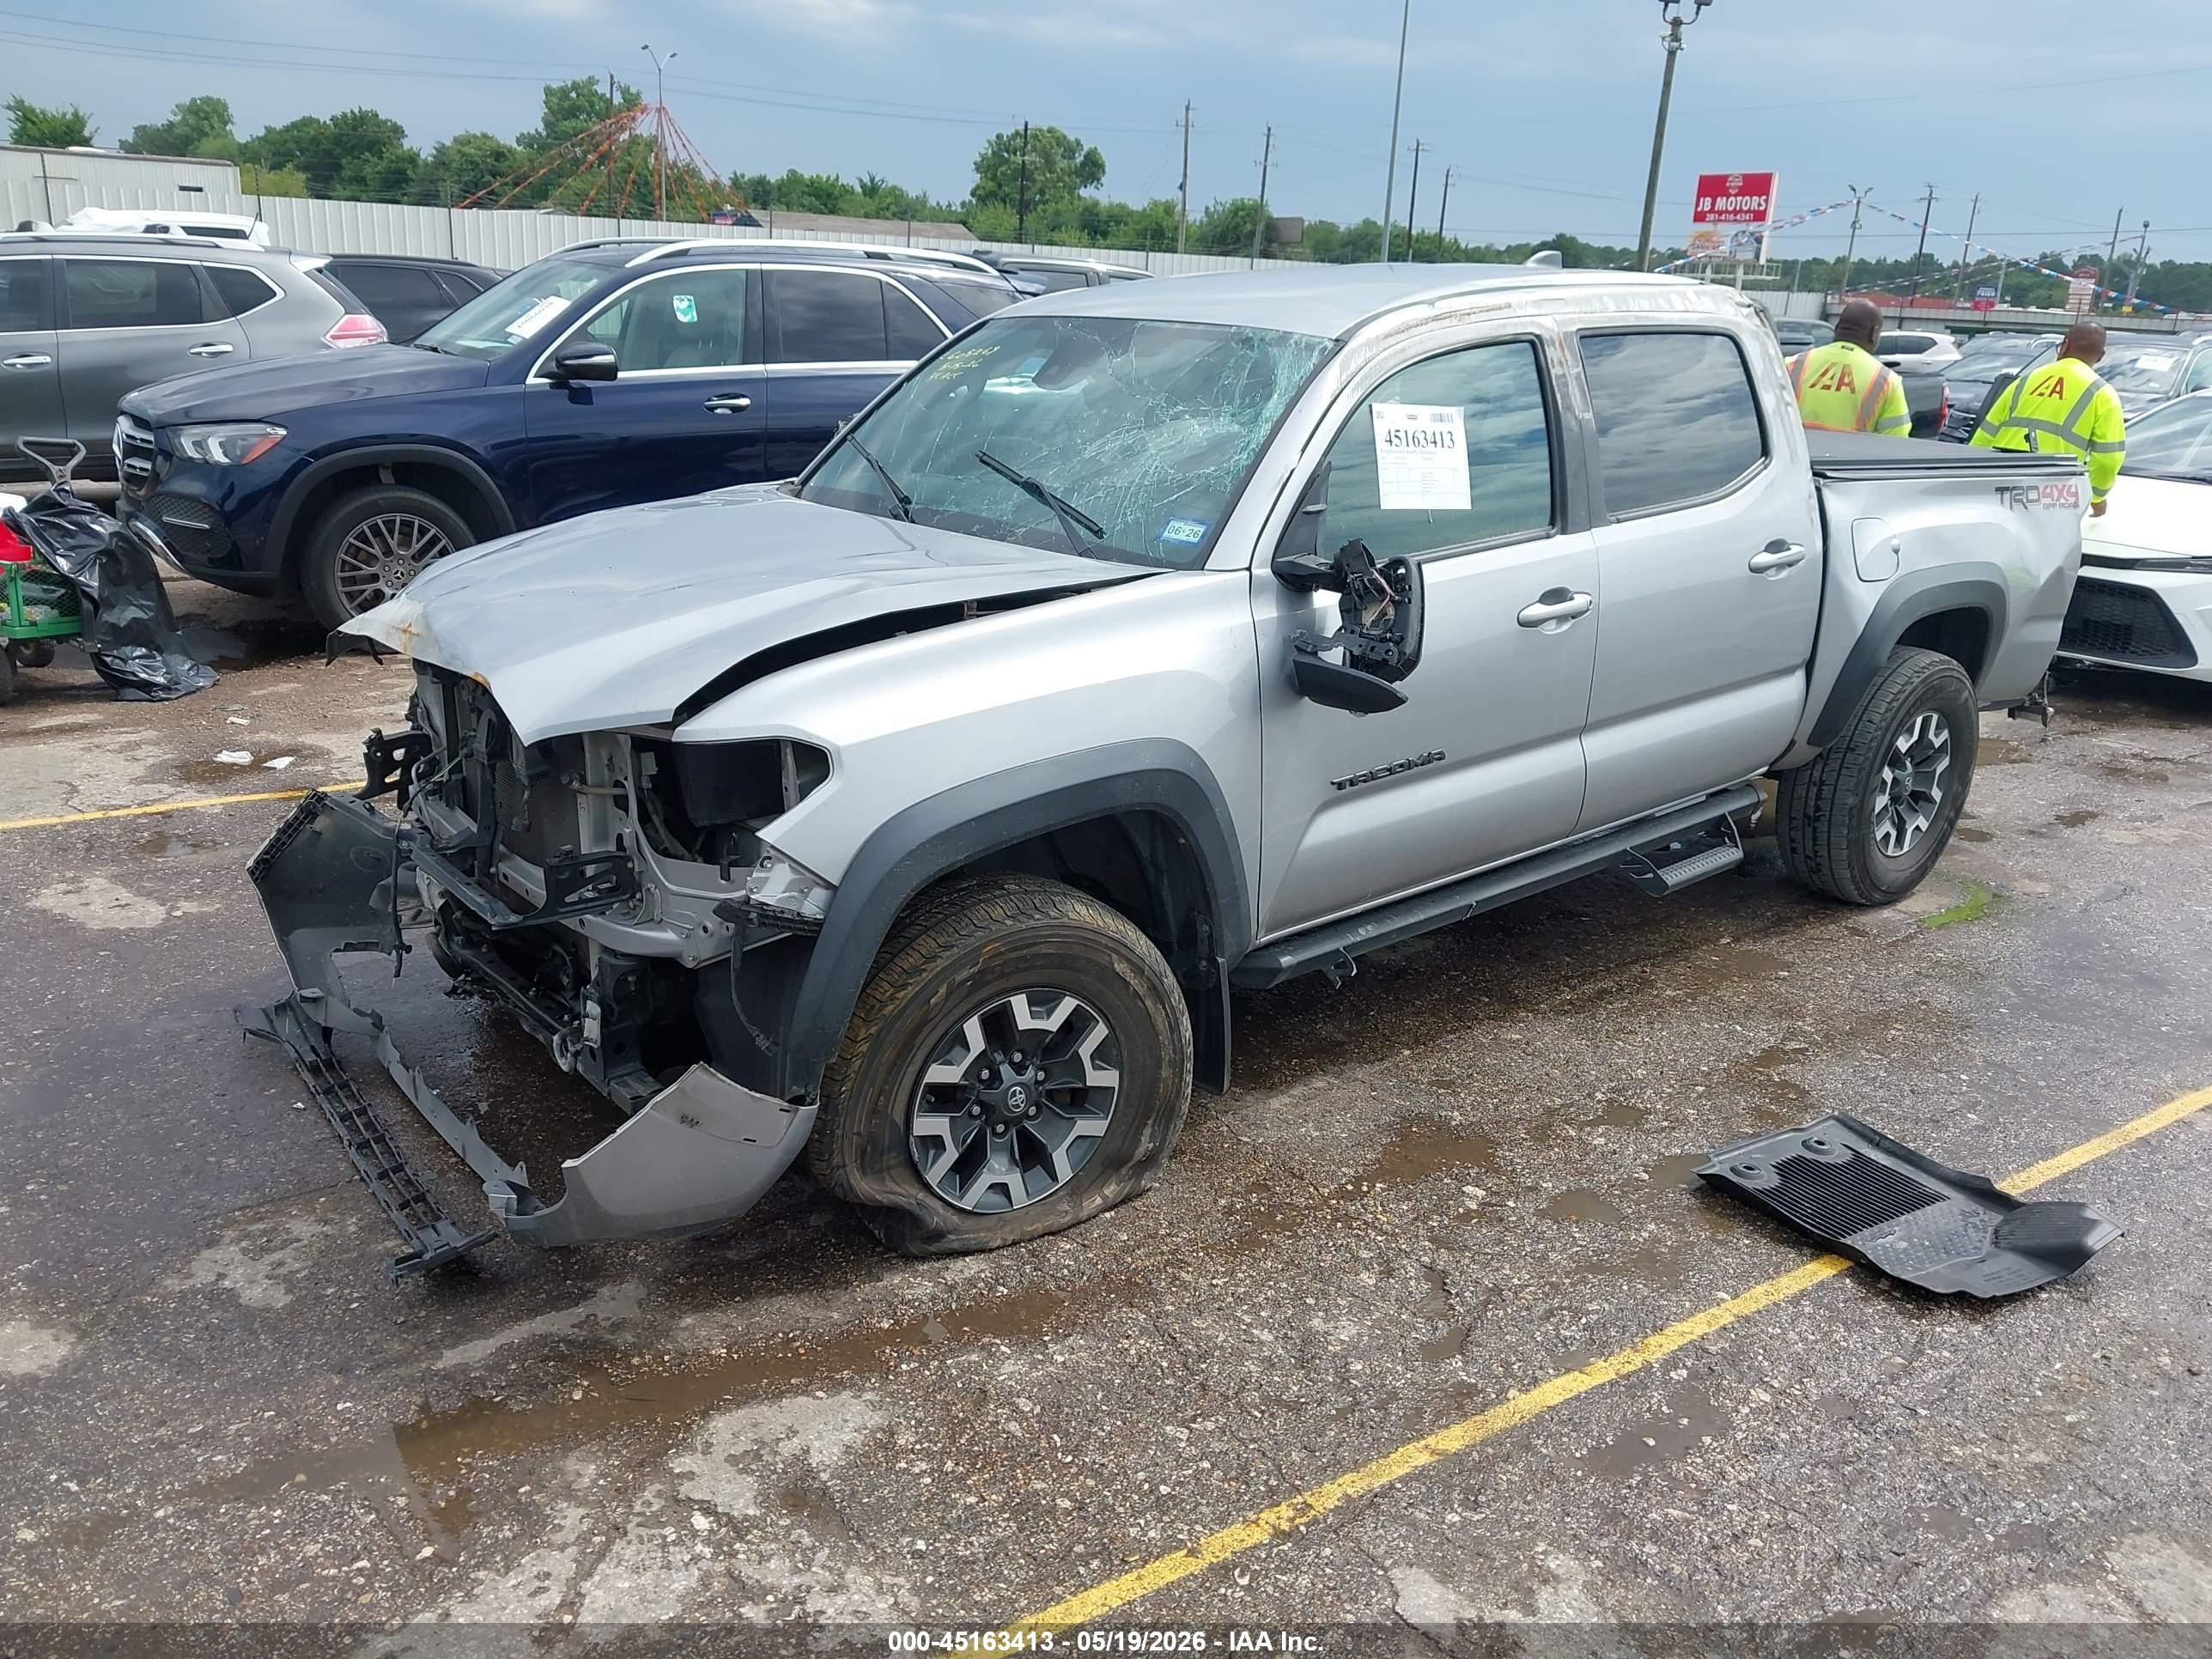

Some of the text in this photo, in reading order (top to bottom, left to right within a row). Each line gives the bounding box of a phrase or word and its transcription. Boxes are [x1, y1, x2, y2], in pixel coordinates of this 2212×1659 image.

[1697, 196, 1767, 211] JB MOTORS
[1384, 428, 1455, 449] 45163413
[1995, 485, 2040, 511] TRD
[1330, 748, 1447, 790] TACOMA
